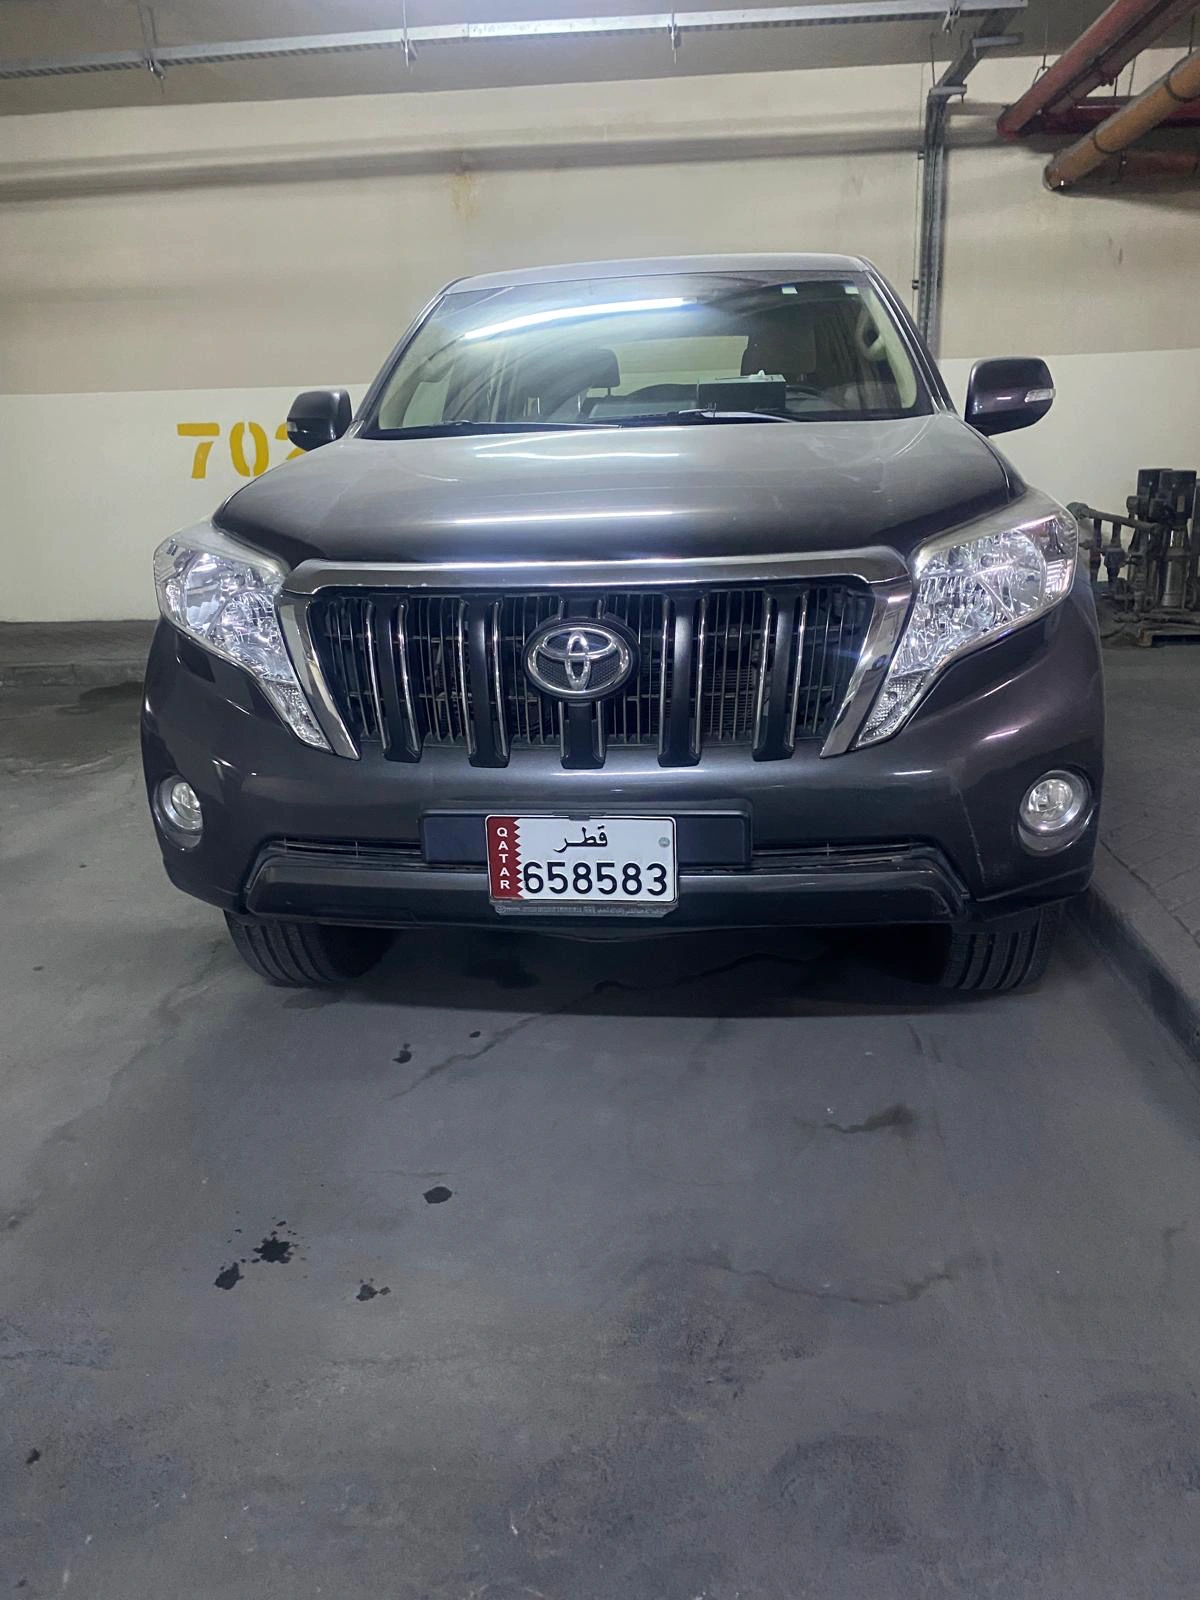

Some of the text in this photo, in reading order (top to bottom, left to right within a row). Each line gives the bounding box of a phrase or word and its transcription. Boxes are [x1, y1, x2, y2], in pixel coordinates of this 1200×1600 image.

[553, 825, 608, 853] قطر
[496, 827, 511, 890] QATAR
[523, 861, 667, 895] 658583
